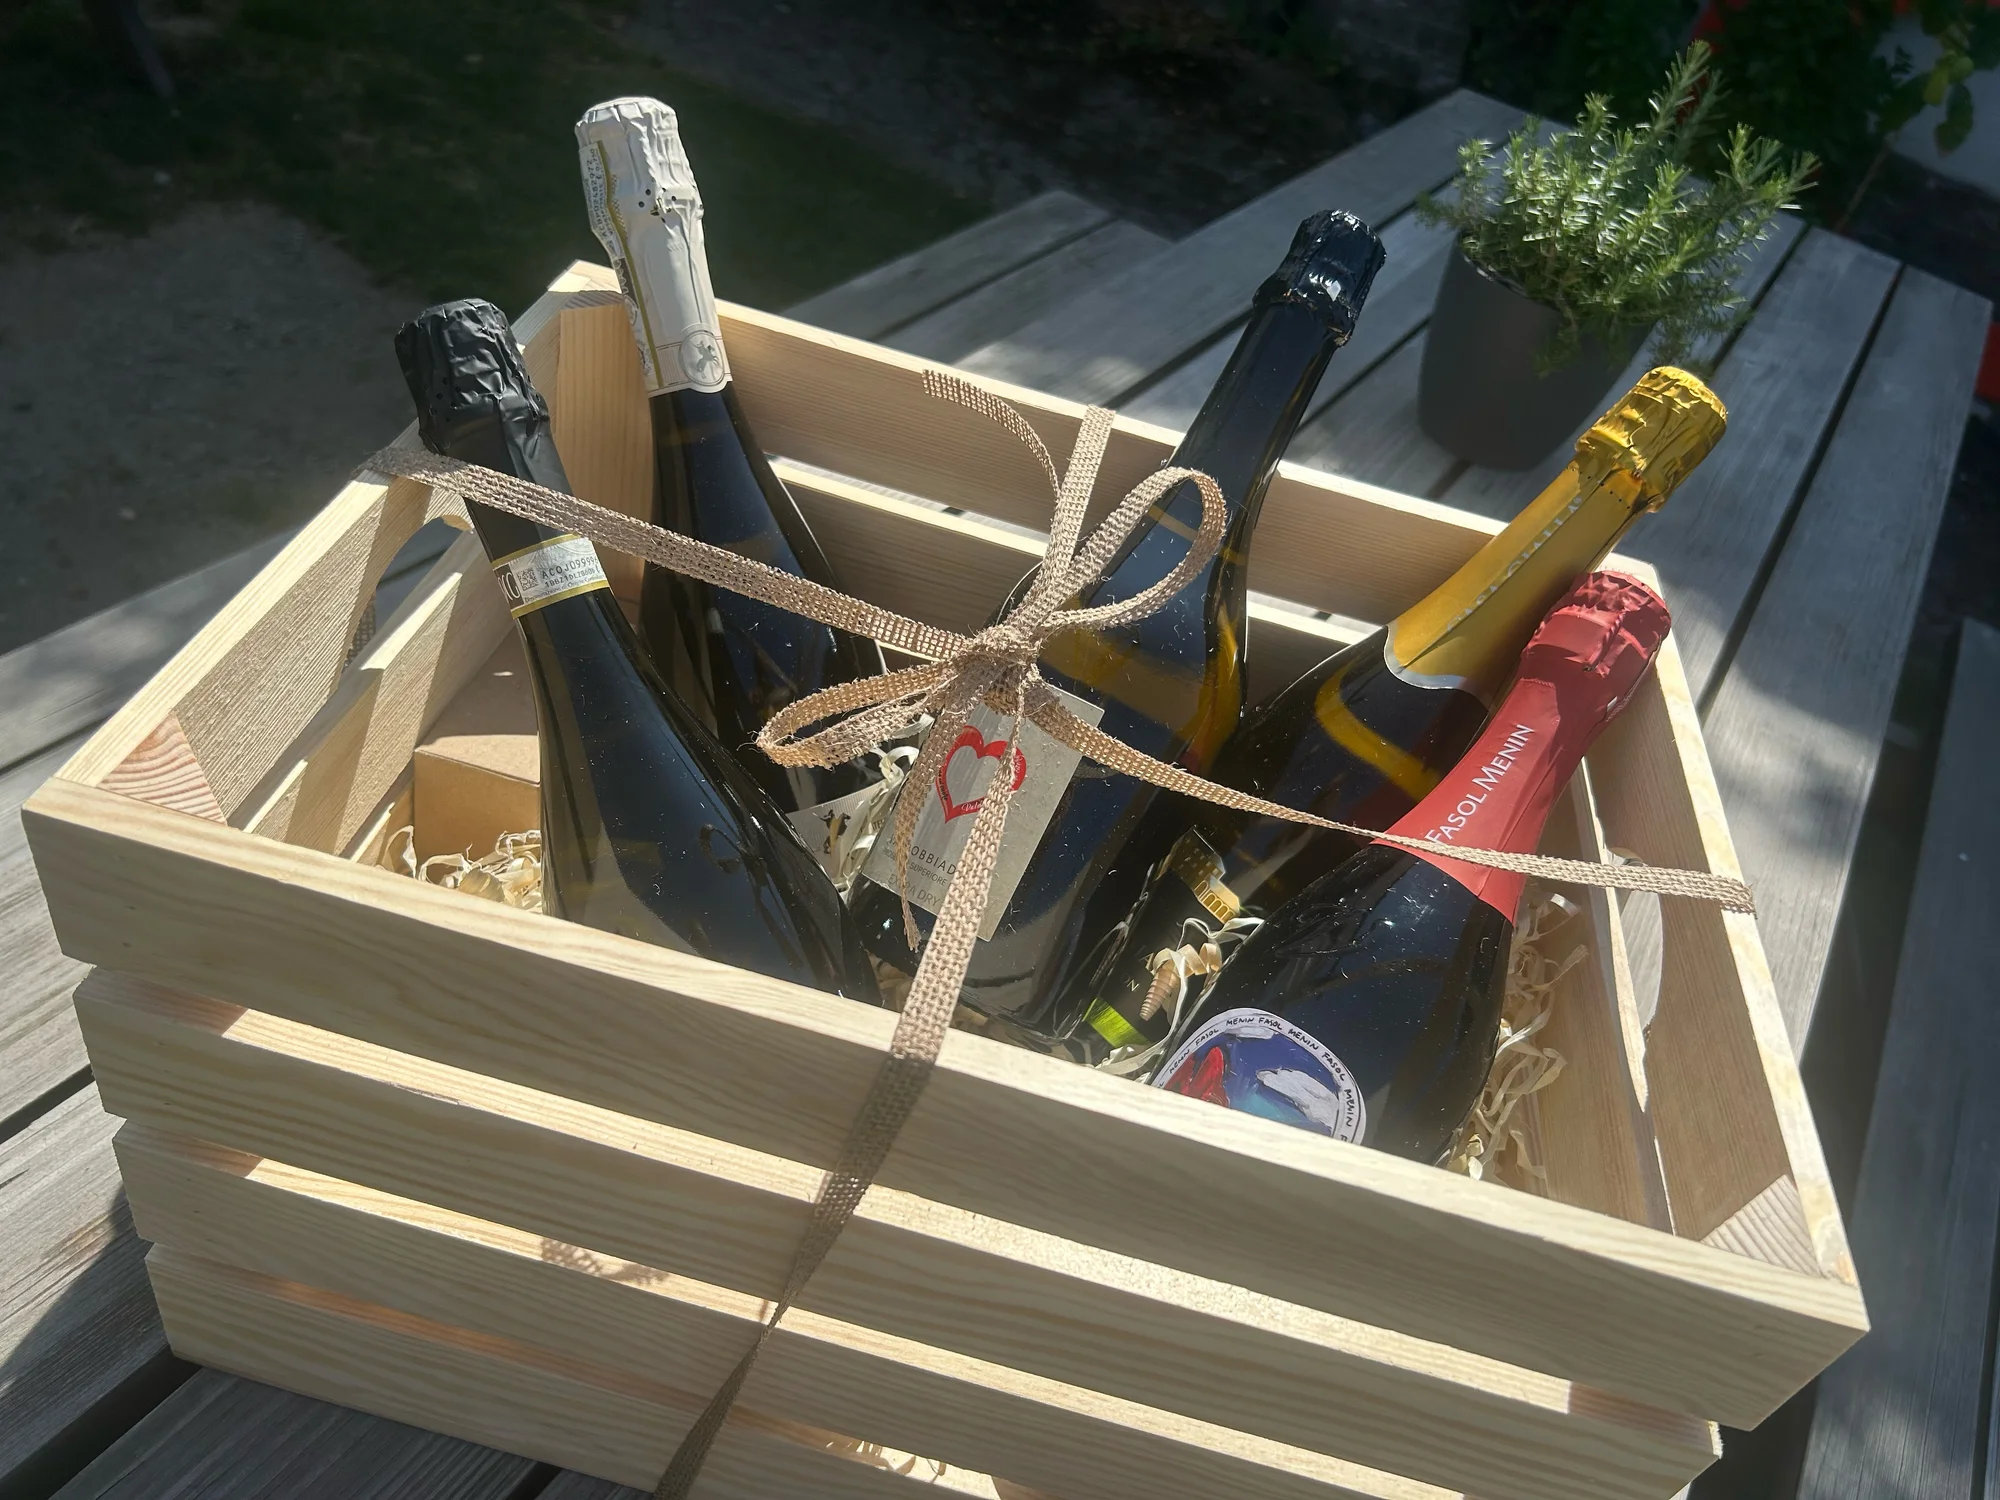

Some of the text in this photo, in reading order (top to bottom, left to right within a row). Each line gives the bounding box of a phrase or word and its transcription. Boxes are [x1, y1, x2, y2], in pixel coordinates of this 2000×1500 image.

[1425, 724, 1535, 846] FASOL MENIN
[888, 873, 942, 906] EXRA DRY
[910, 862, 948, 887] SUPERIORE
[1195, 1028, 1219, 1047] FASOL
[1225, 1017, 1255, 1027] MENIN
[1258, 1017, 1283, 1031] FASOL
[1288, 1028, 1320, 1051] MENIN
[1321, 1053, 1346, 1082] FASOL
[1344, 1088, 1356, 1127] MENIN
